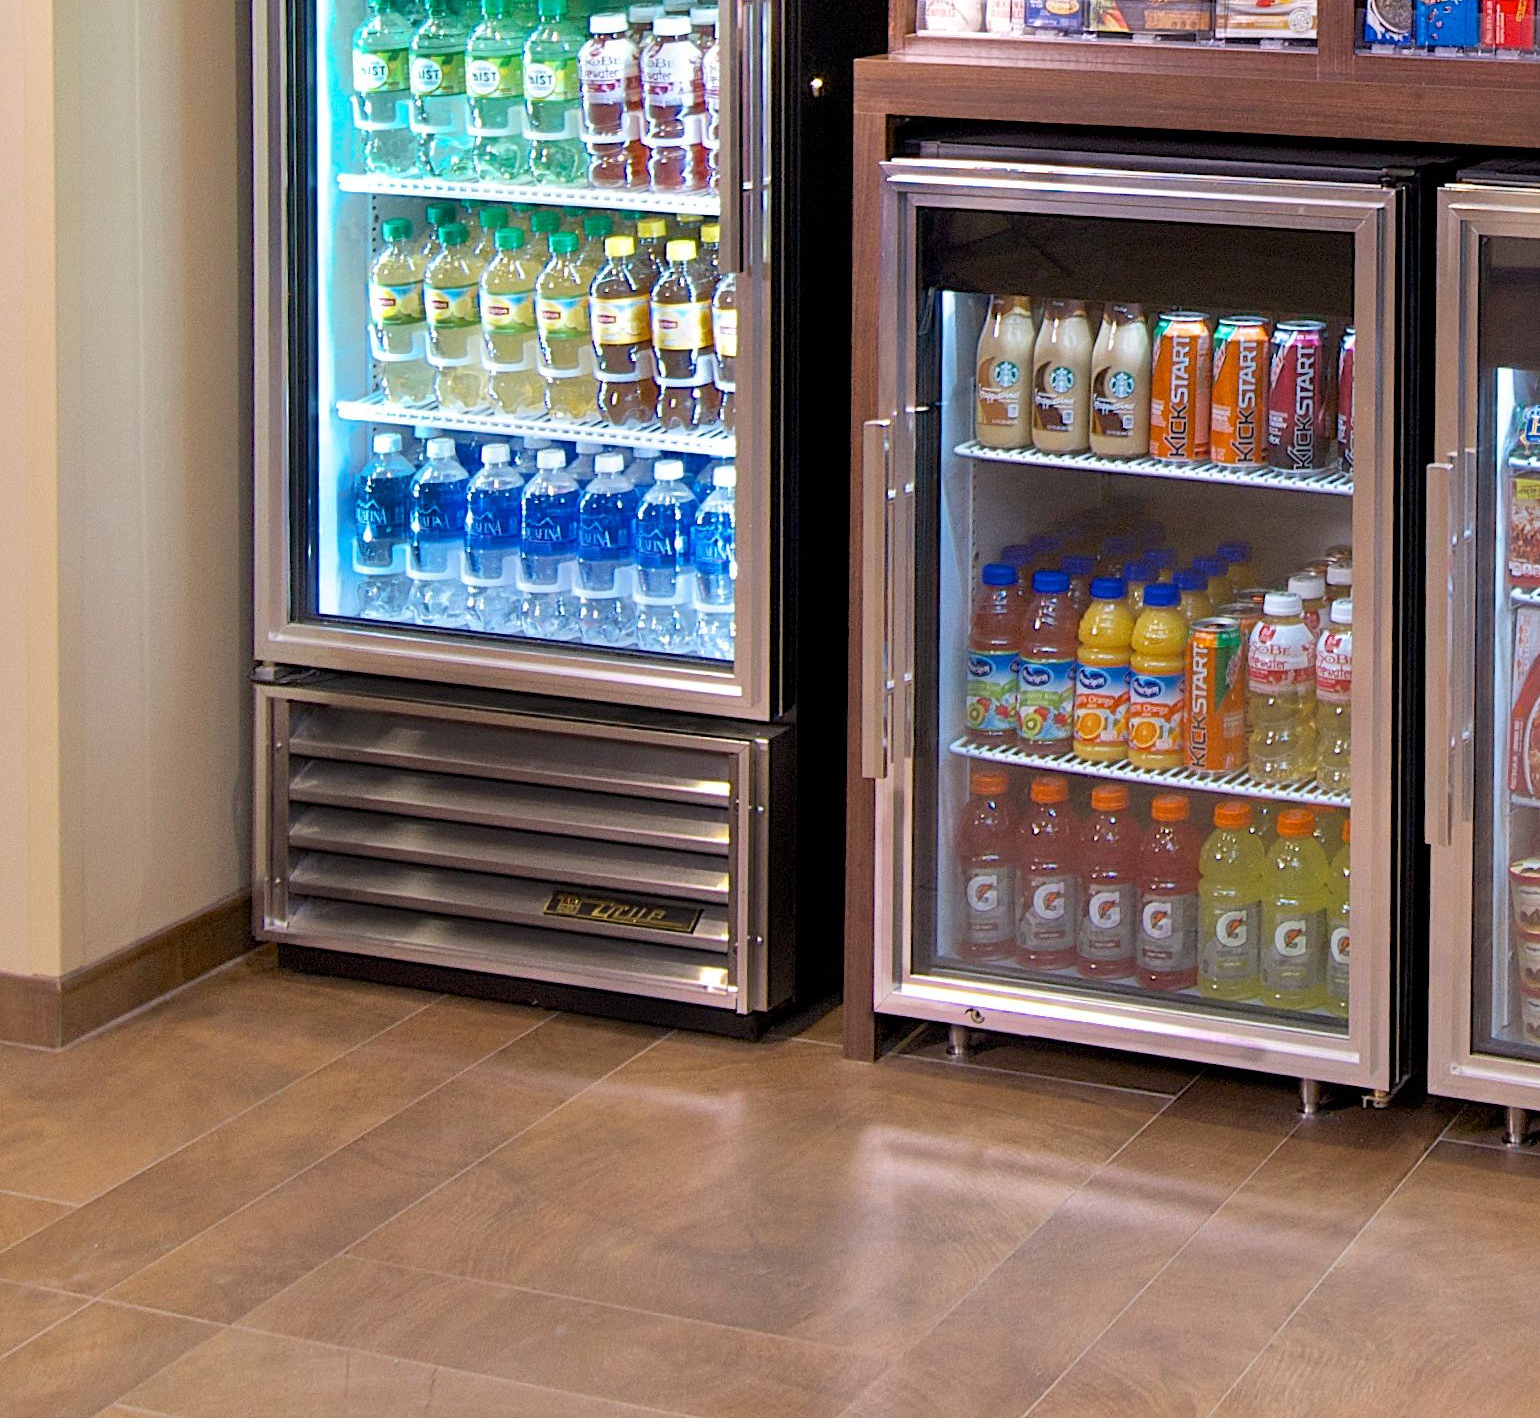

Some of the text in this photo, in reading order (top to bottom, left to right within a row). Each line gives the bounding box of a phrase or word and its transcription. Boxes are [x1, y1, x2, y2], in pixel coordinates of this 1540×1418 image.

[1165, 336, 1191, 459] KICKSTART
[1233, 340, 1258, 463] KICKSTART
[1288, 345, 1314, 470] KICKSTART
[1088, 695, 1114, 707] Orange
[1191, 643, 1209, 769] KICKSTART
[966, 875, 998, 912] G
[1033, 881, 1065, 920] G
[1089, 892, 1120, 929] G
[1142, 901, 1173, 940] G
[1215, 911, 1247, 948] G
[1274, 920, 1307, 957] G
